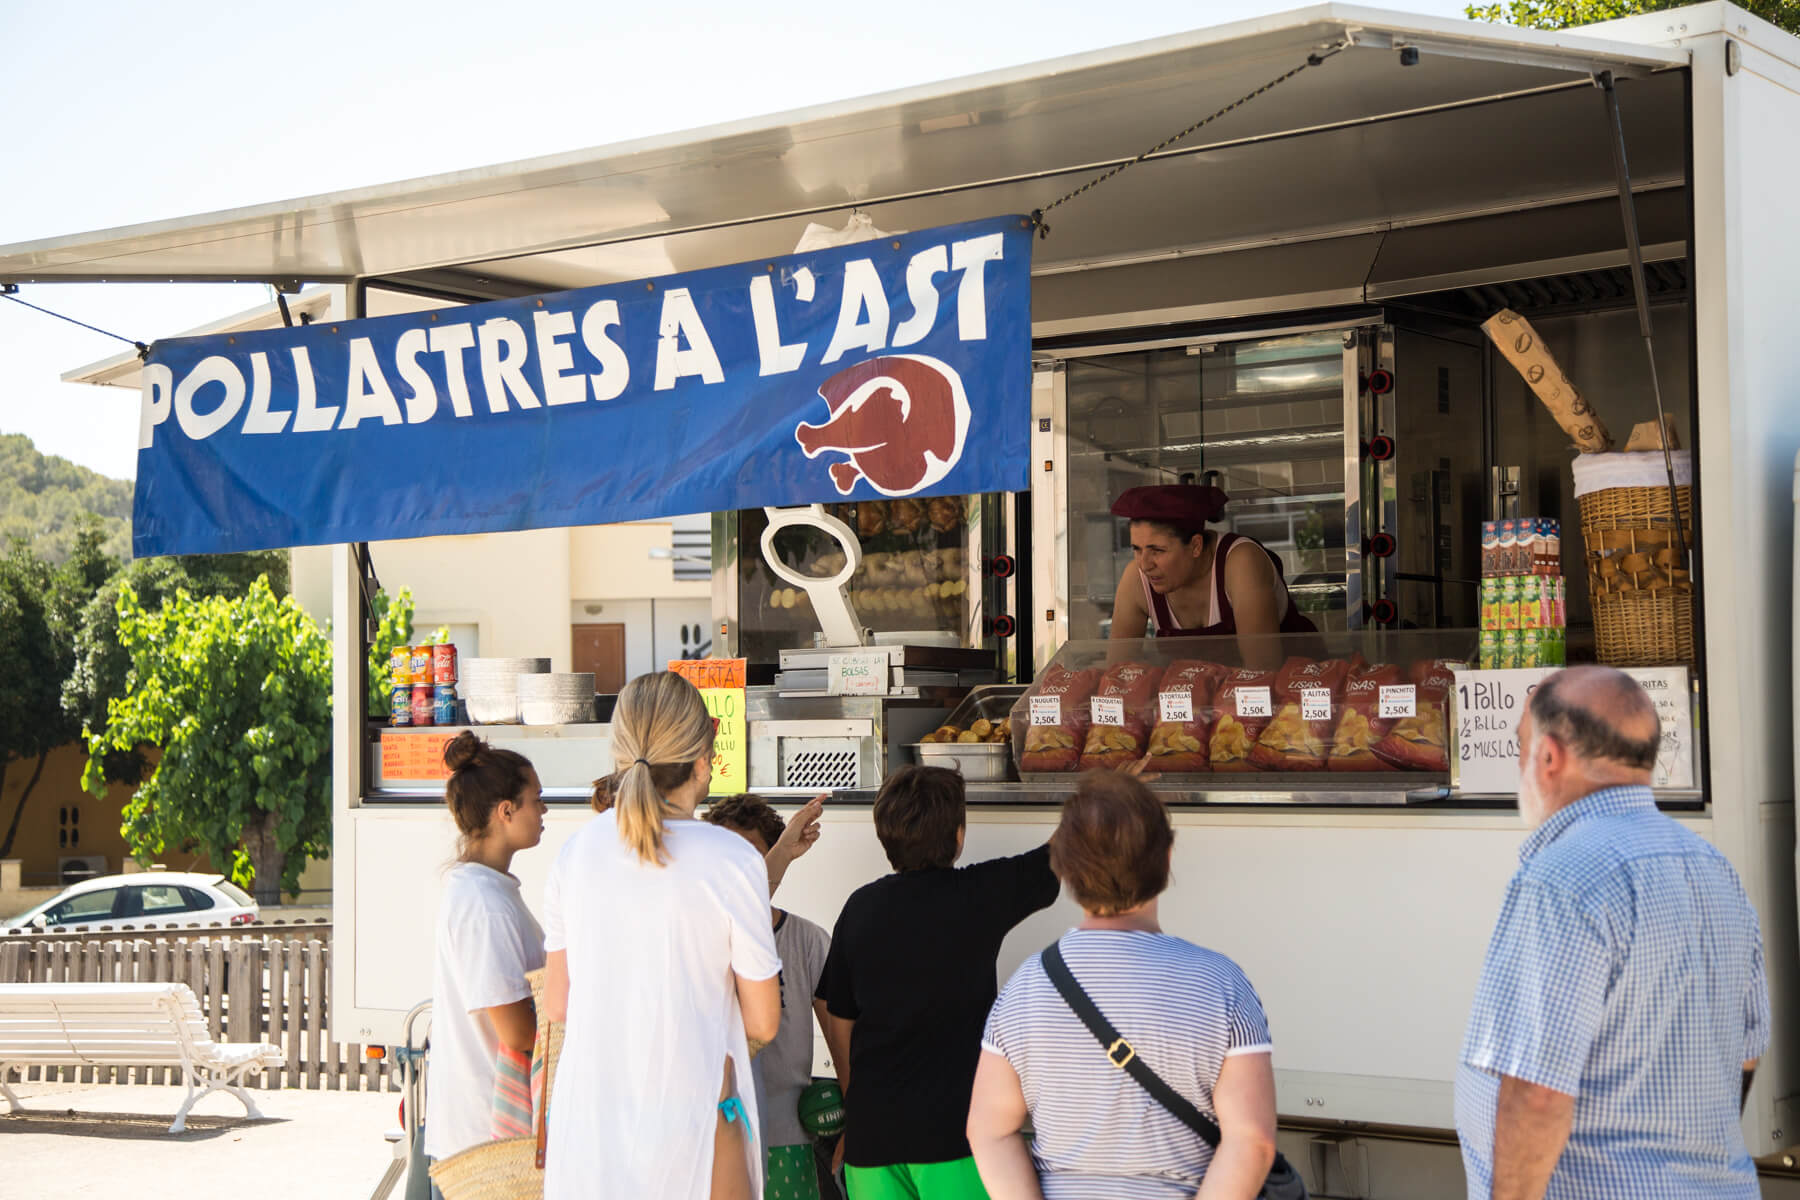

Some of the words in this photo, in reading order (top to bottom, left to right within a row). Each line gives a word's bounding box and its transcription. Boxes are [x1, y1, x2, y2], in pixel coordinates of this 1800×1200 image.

[138, 299, 630, 448] POLLASTRES
[654, 287, 725, 391] A
[749, 232, 1004, 377] L'AST
[841, 665, 869, 677] BOLSAS
[1288, 680, 1322, 689] LISAS
[1421, 676, 1449, 687] LISA
[1459, 684, 1469, 710] 1
[1474, 681, 1514, 710] Pollo
[1166, 711, 1188, 720] 2,50€
[1242, 706, 1265, 716] 2,50€
[1305, 710, 1328, 719] 2,50€
[1384, 706, 1409, 715] 2,50€
[1035, 716, 1056, 725] 2,50€
[1098, 714, 1119, 724] 2,50€
[1461, 743, 1471, 761] 2
